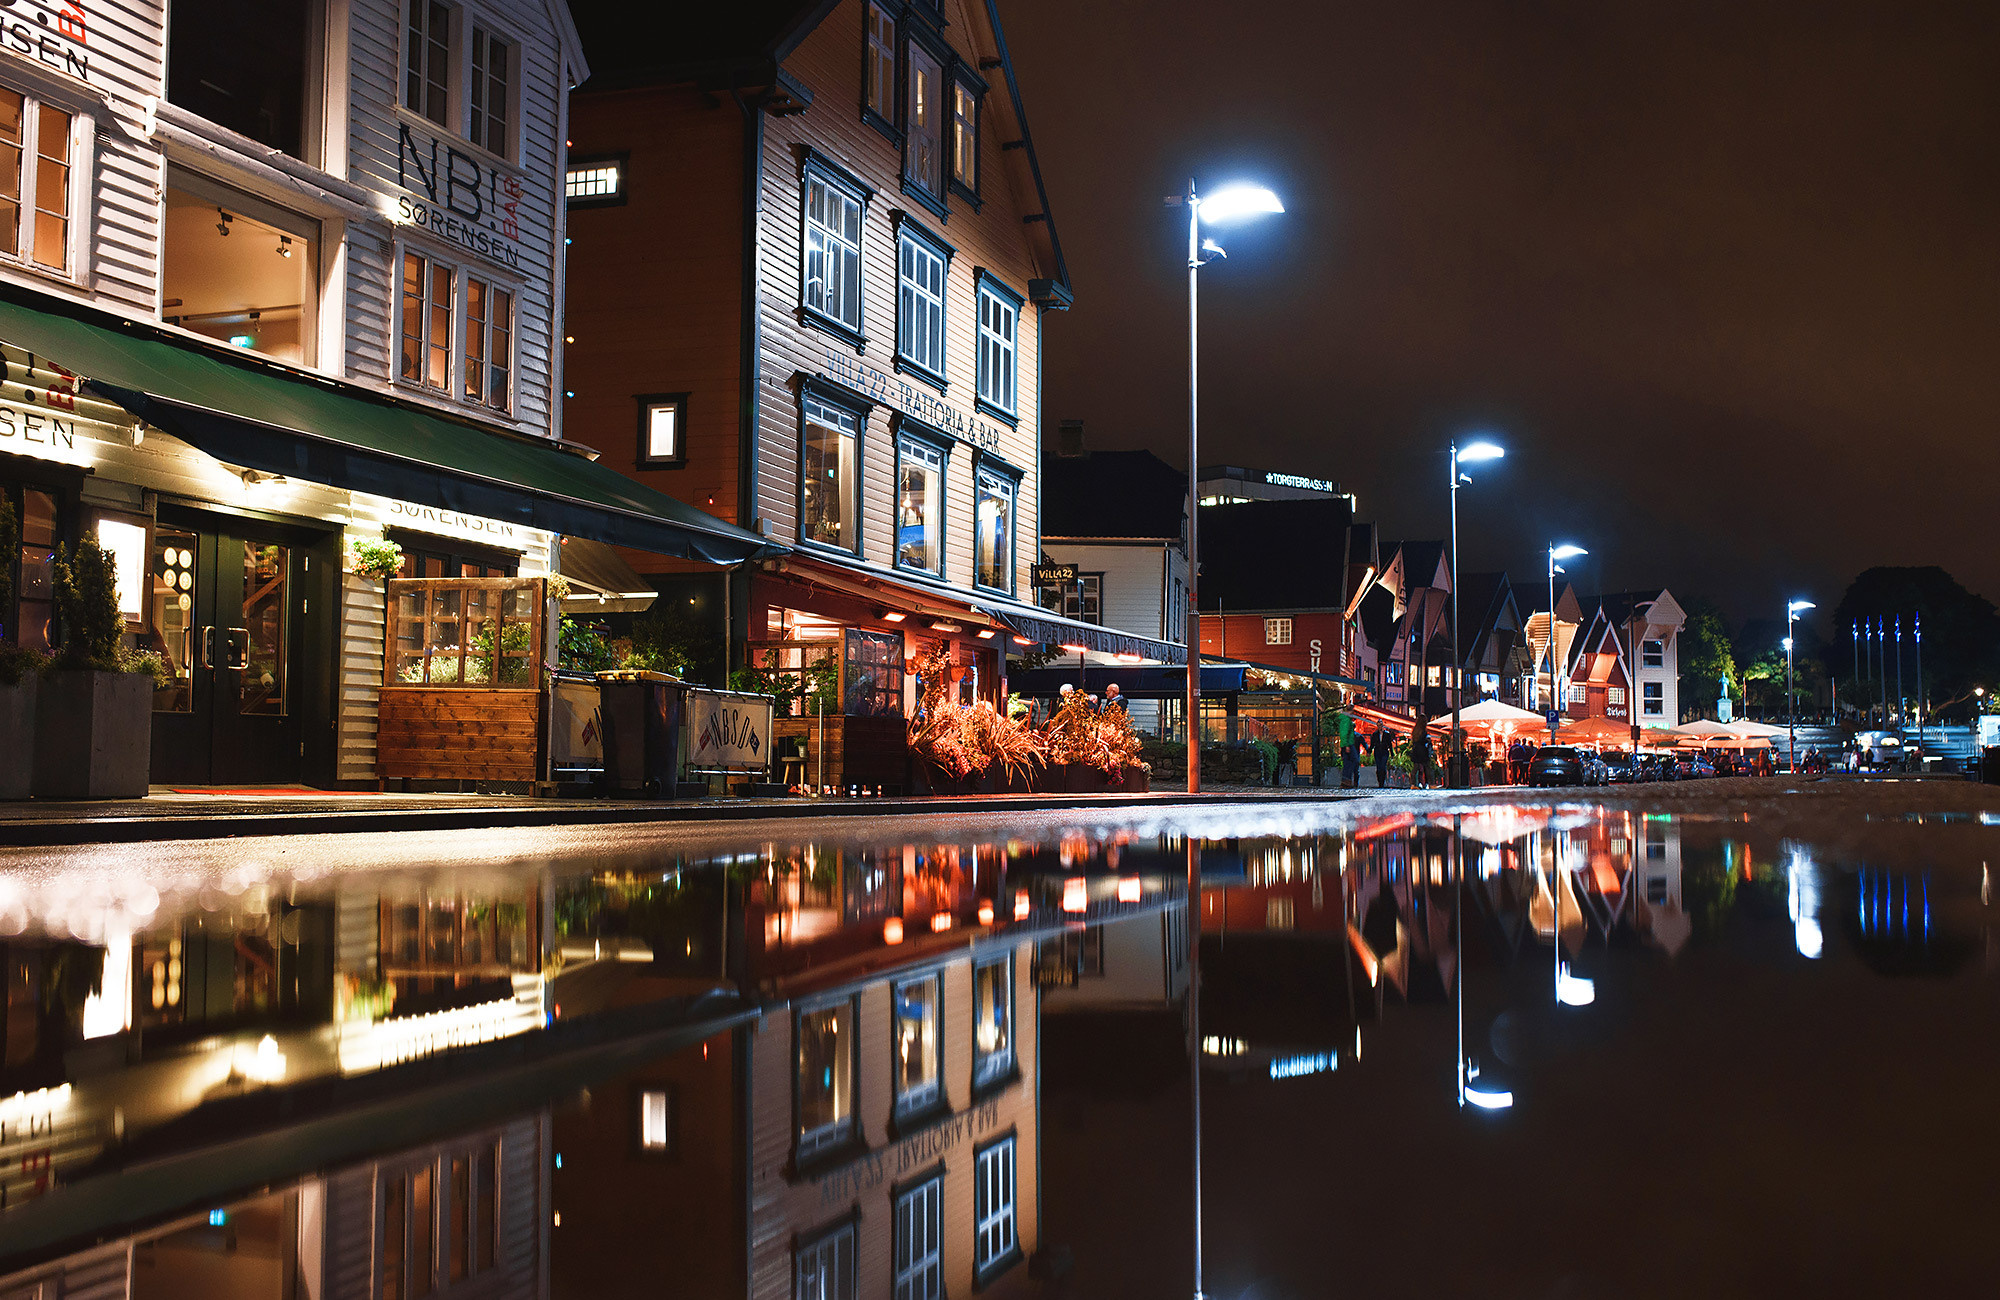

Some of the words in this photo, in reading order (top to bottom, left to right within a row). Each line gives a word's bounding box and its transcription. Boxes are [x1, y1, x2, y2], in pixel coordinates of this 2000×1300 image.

[399, 122, 498, 231] NB!
[503, 177, 523, 242] BAR
[399, 196, 519, 266] SØRENSEN
[827, 351, 867, 392] VILLA
[869, 370, 887, 404] 22
[899, 382, 964, 439] TRATTORIA
[968, 417, 977, 444] &
[979, 422, 1000, 454] BAR
[1062, 569, 1073, 578] 22
[1549, 711, 1556, 721] P
